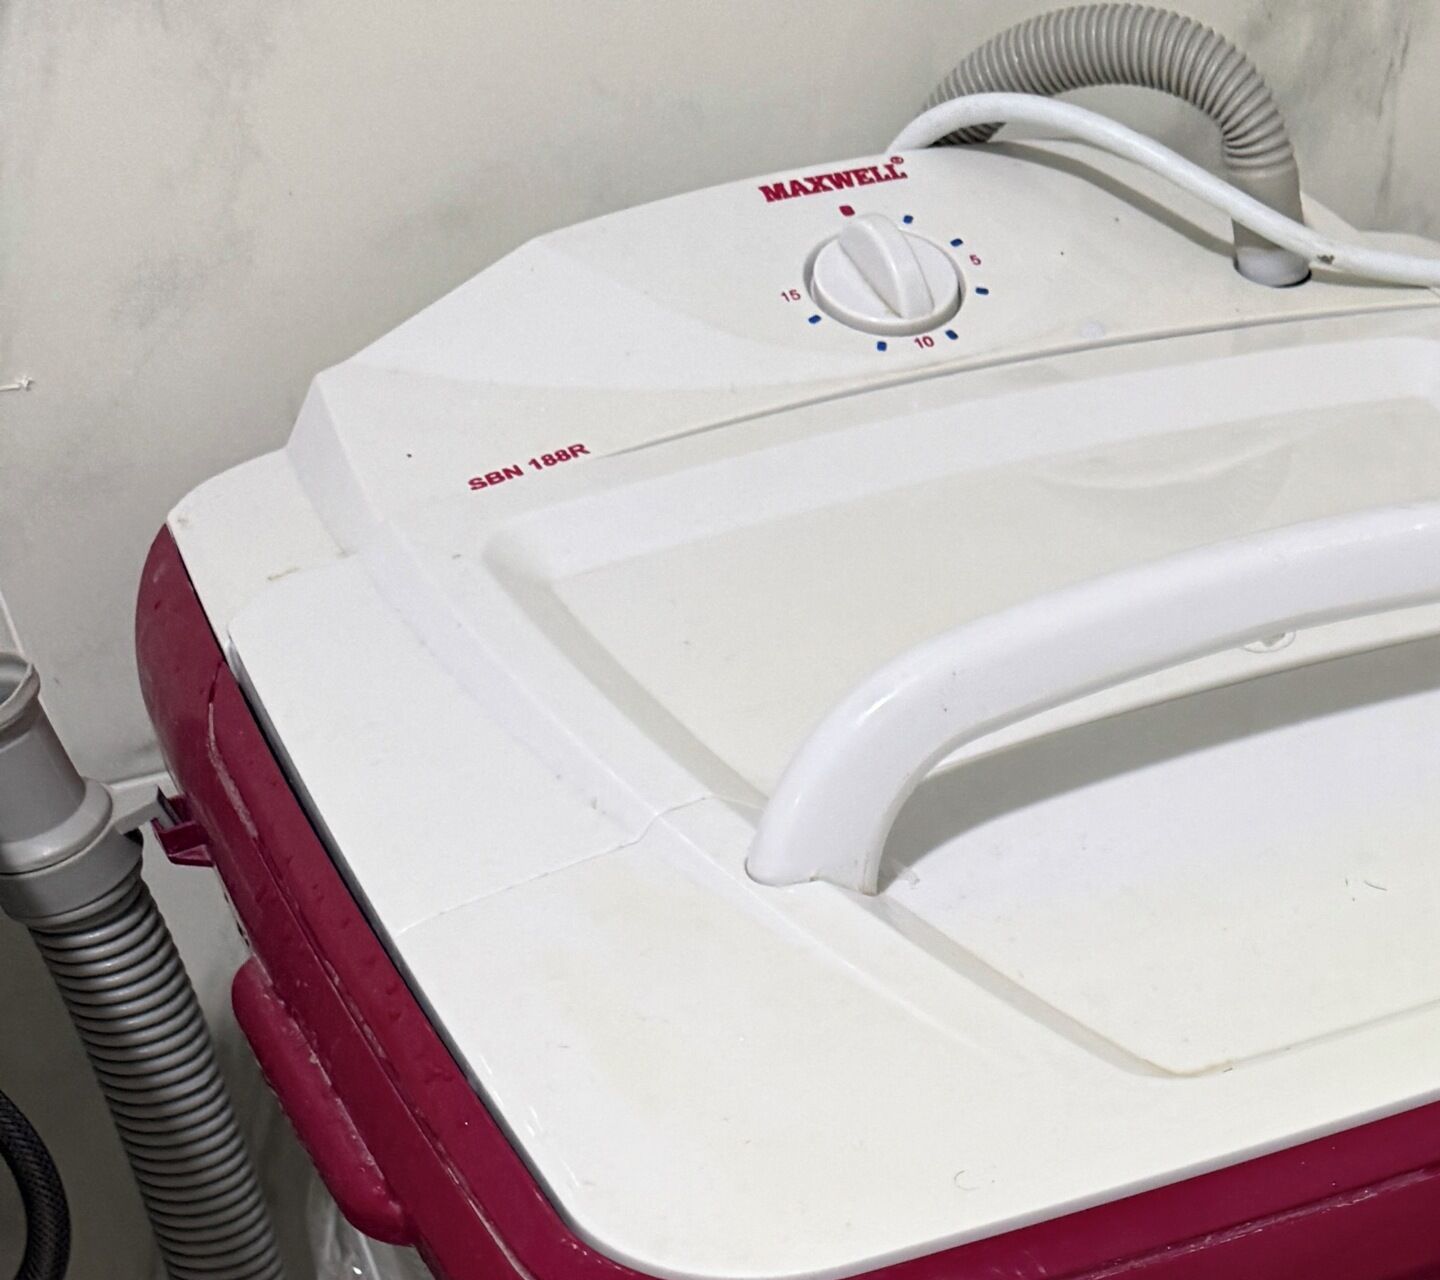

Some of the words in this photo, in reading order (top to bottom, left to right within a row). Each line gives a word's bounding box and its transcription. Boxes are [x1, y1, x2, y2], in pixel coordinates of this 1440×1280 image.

[968, 253, 982, 266] 5
[780, 288, 802, 304] 15
[914, 335, 935, 350] 10
[467, 464, 525, 491] SBN
[528, 443, 591, 470] 188R
